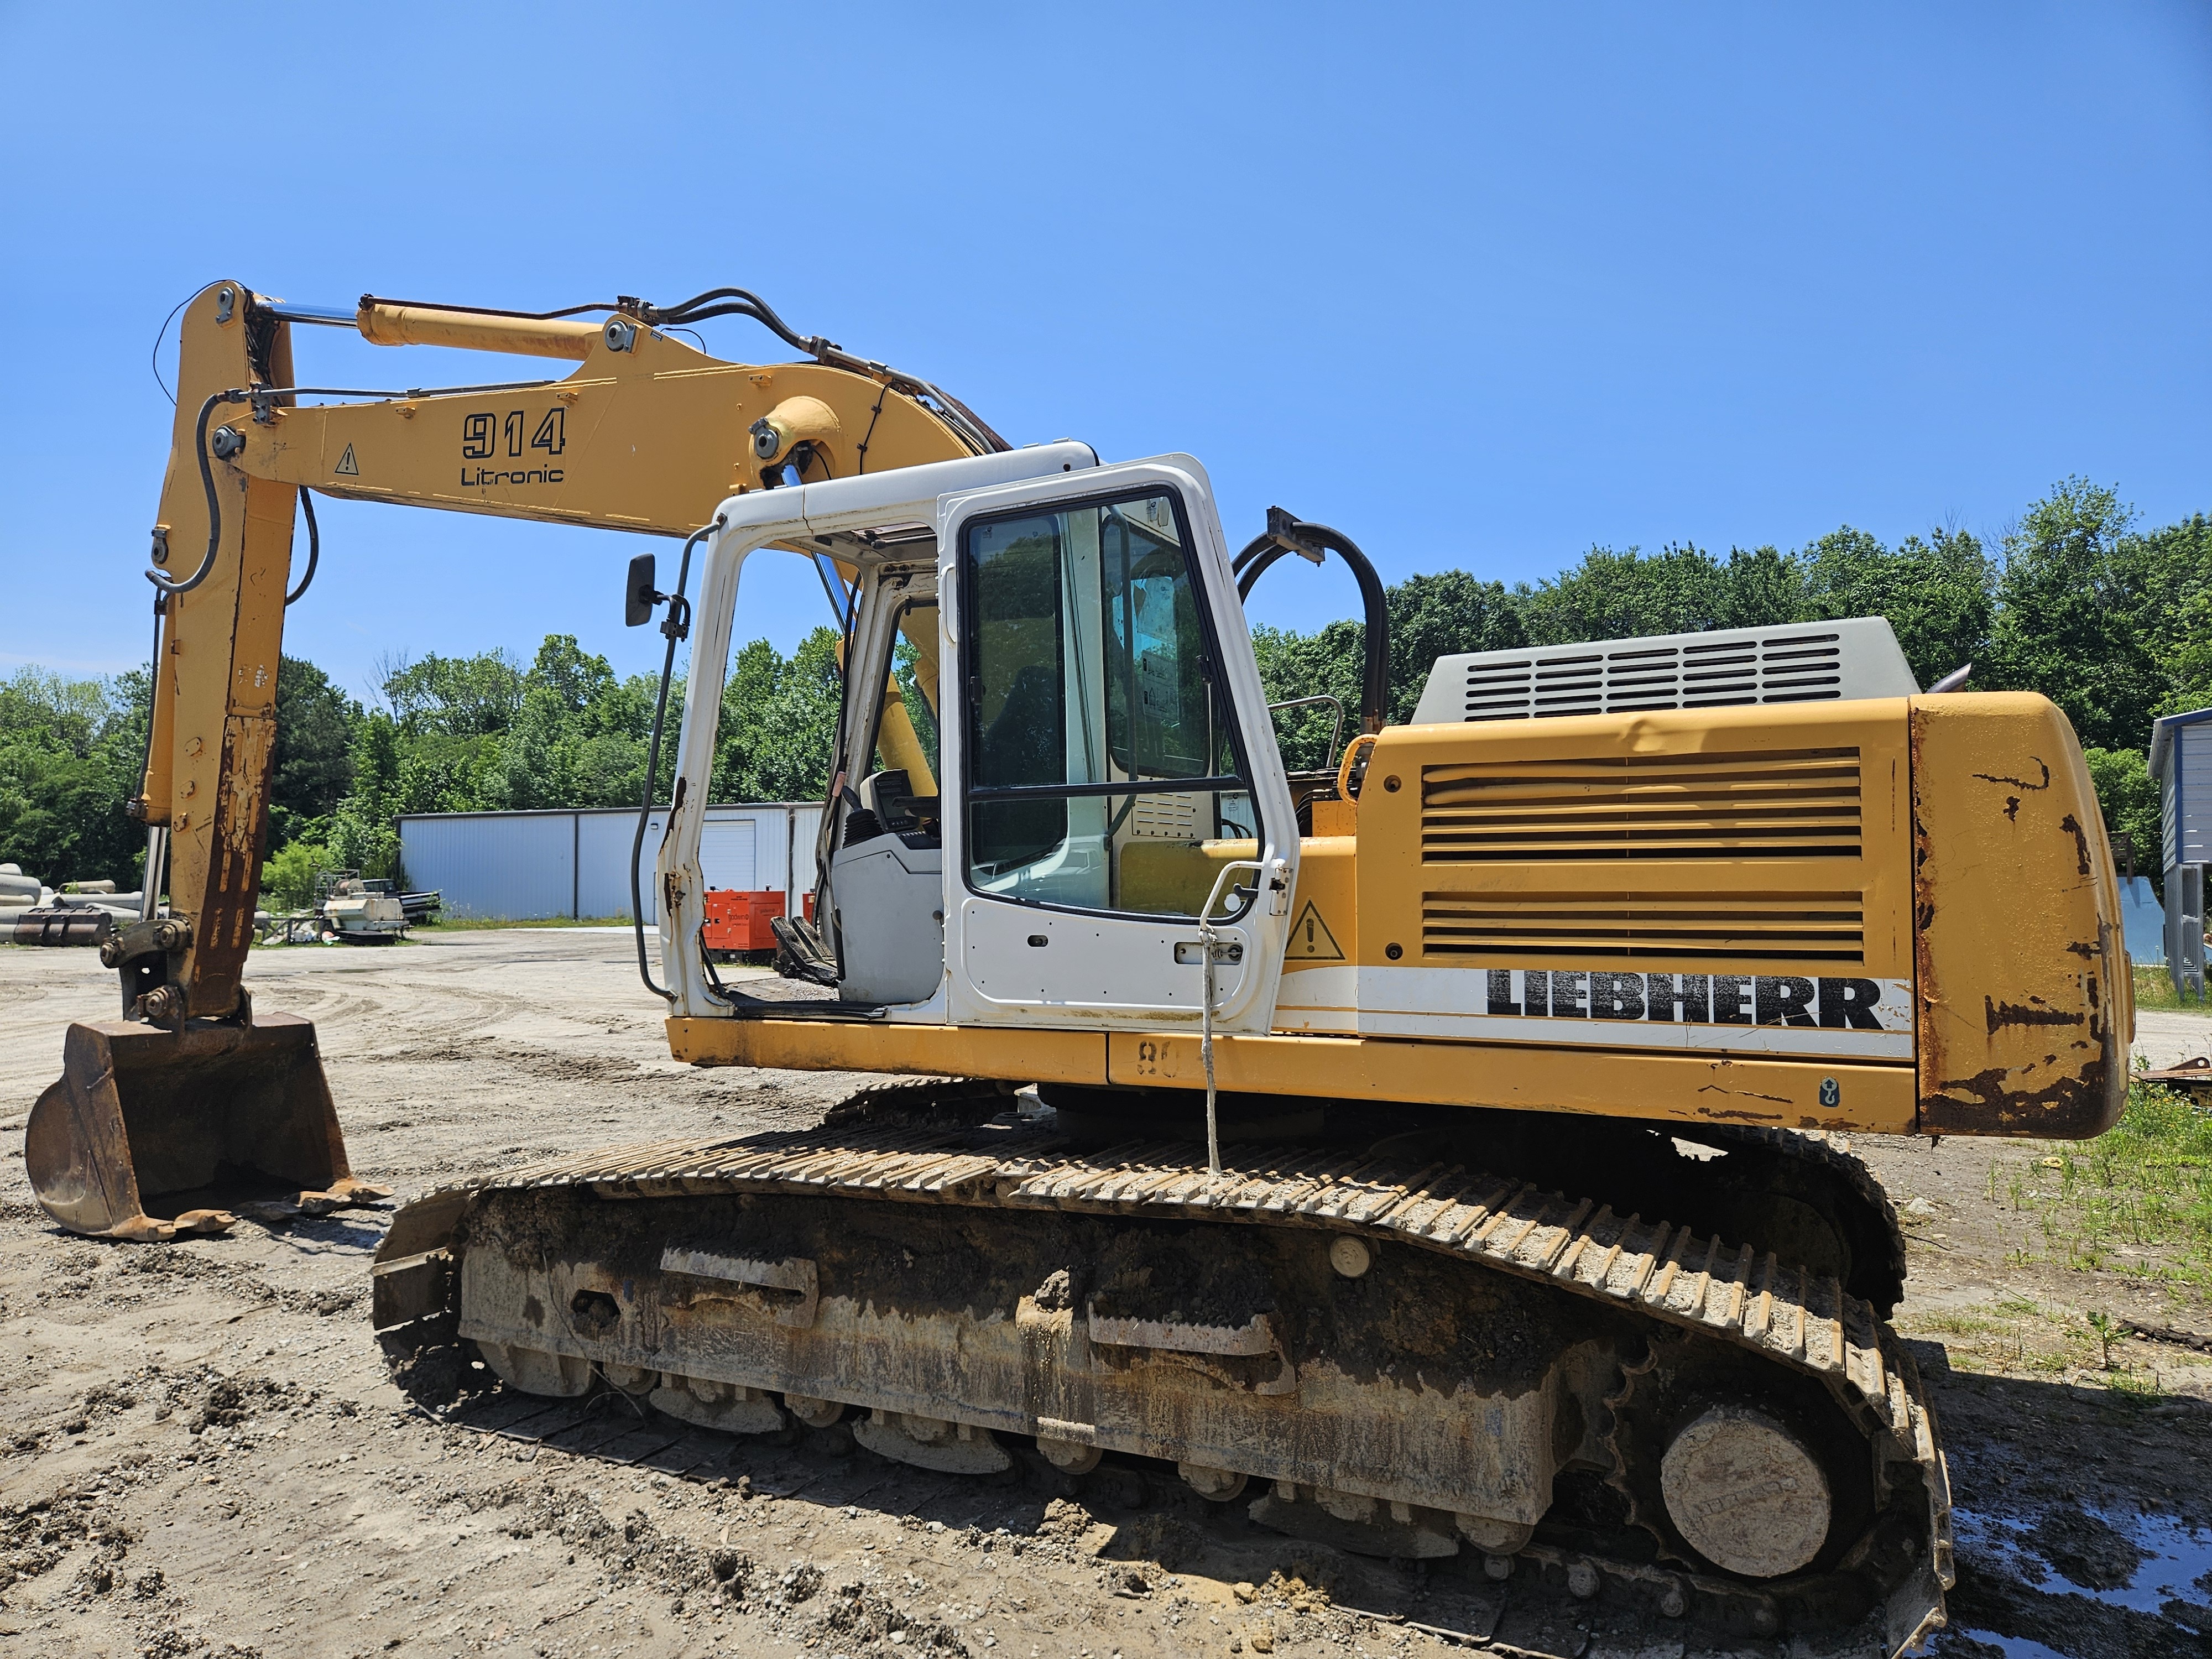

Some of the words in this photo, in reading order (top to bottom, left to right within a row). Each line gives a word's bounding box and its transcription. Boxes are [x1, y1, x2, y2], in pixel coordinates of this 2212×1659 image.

[463, 407, 565, 459] 914
[461, 464, 564, 486] Litronic
[1488, 969, 1884, 1030] LIEBHERR
